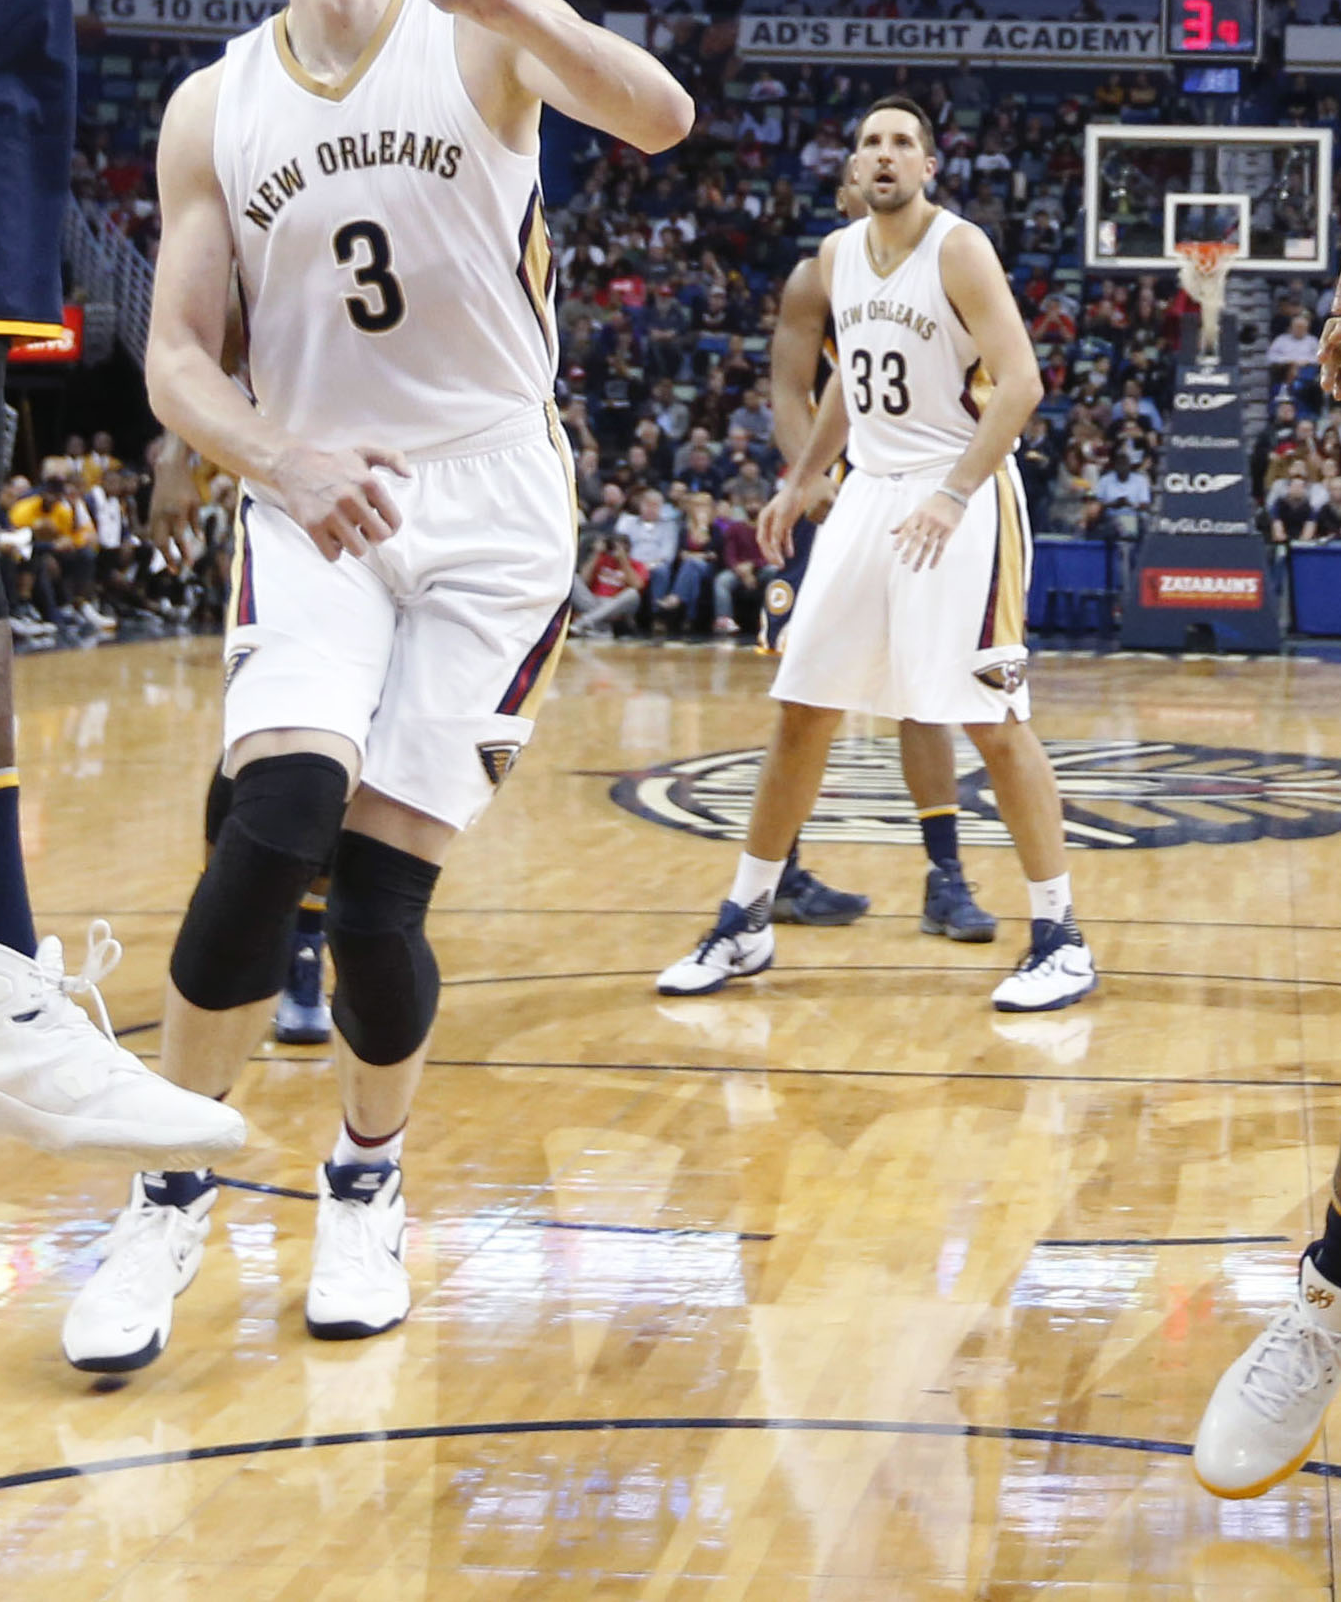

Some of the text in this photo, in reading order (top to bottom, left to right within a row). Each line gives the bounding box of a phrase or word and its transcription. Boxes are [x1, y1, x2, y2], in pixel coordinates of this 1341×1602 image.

[750, 22, 1156, 52] AD'S FLIGHT ACADEMY
[244, 129, 463, 232] NEW ORLEANS
[332, 218, 407, 335] 3
[868, 299, 937, 341] ORLEANS
[851, 348, 911, 416] 33
[1164, 473, 1227, 494] GLO
[1158, 518, 1249, 535] flyGLO.com
[1158, 575, 1259, 593] ZATARAIN'S
